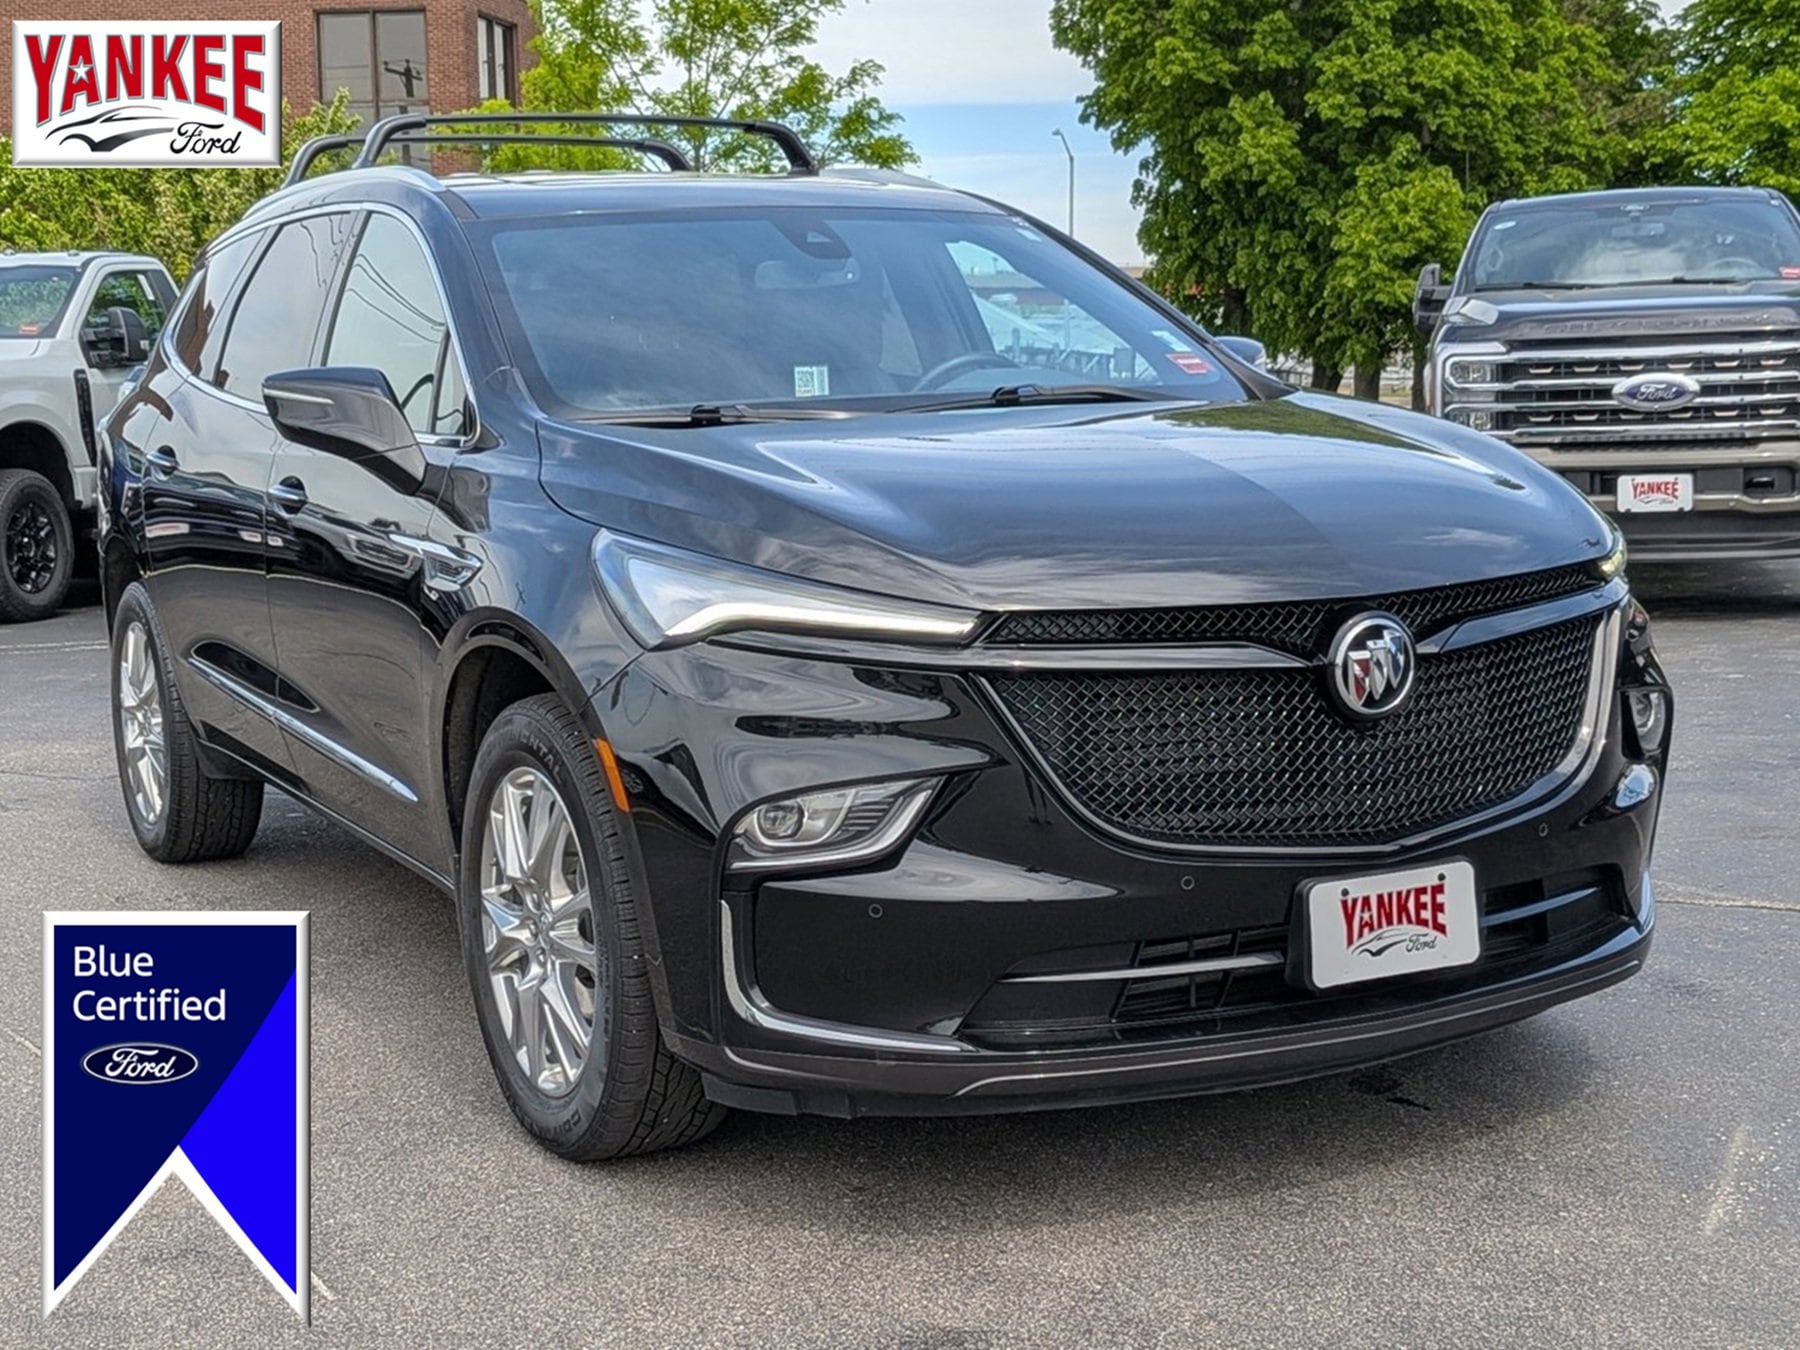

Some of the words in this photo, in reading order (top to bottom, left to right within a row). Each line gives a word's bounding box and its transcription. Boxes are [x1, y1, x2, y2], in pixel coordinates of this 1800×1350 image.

[1636, 383, 1678, 400] Ford
[1631, 481, 1679, 500] YANKEE
[1340, 882, 1448, 949] YANKEE
[1406, 933, 1437, 952] Ford
